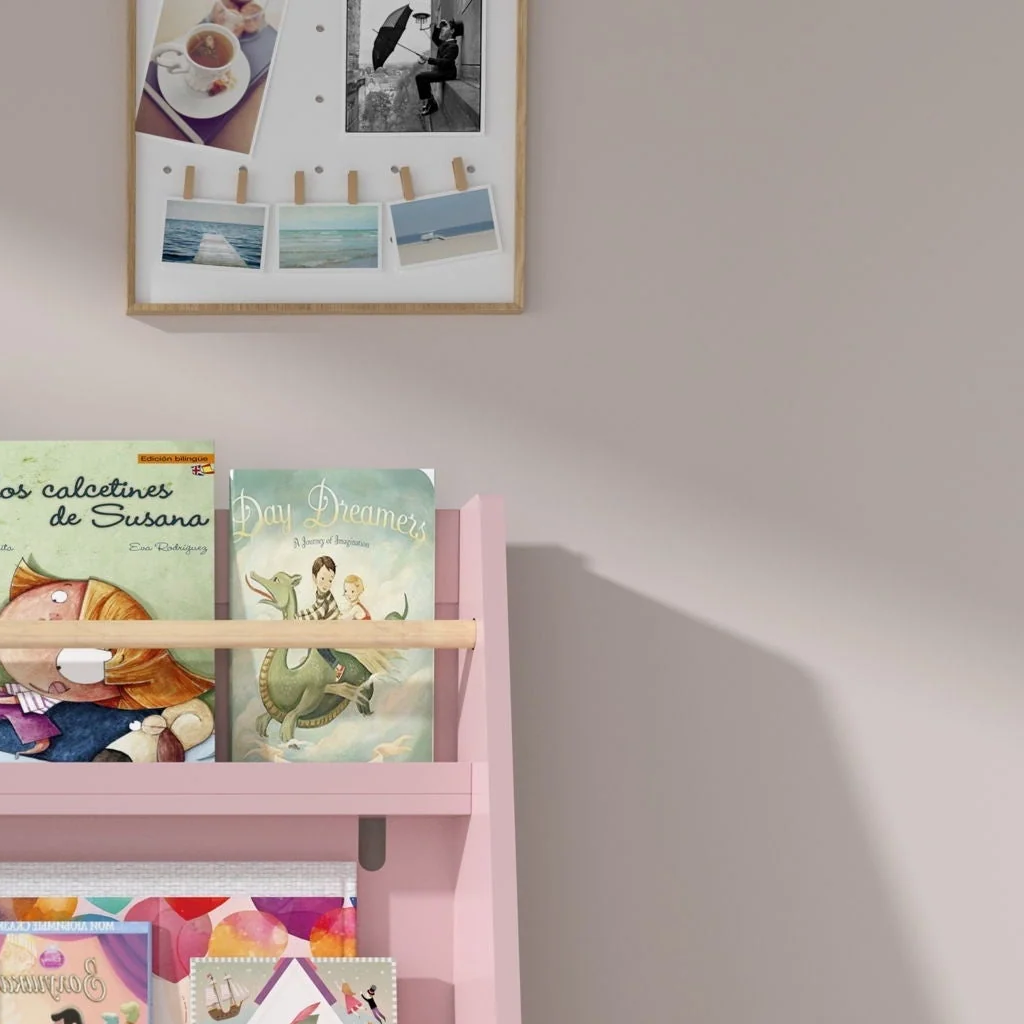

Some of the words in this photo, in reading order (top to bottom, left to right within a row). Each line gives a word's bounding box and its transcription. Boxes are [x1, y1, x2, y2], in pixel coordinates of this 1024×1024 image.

[42, 476, 174, 500] calcetines
[49, 505, 82, 527] de
[91, 503, 211, 528] Susana
[232, 487, 292, 544] Day
[303, 477, 427, 543] Dreamers
[129, 542, 153, 552] Eva
